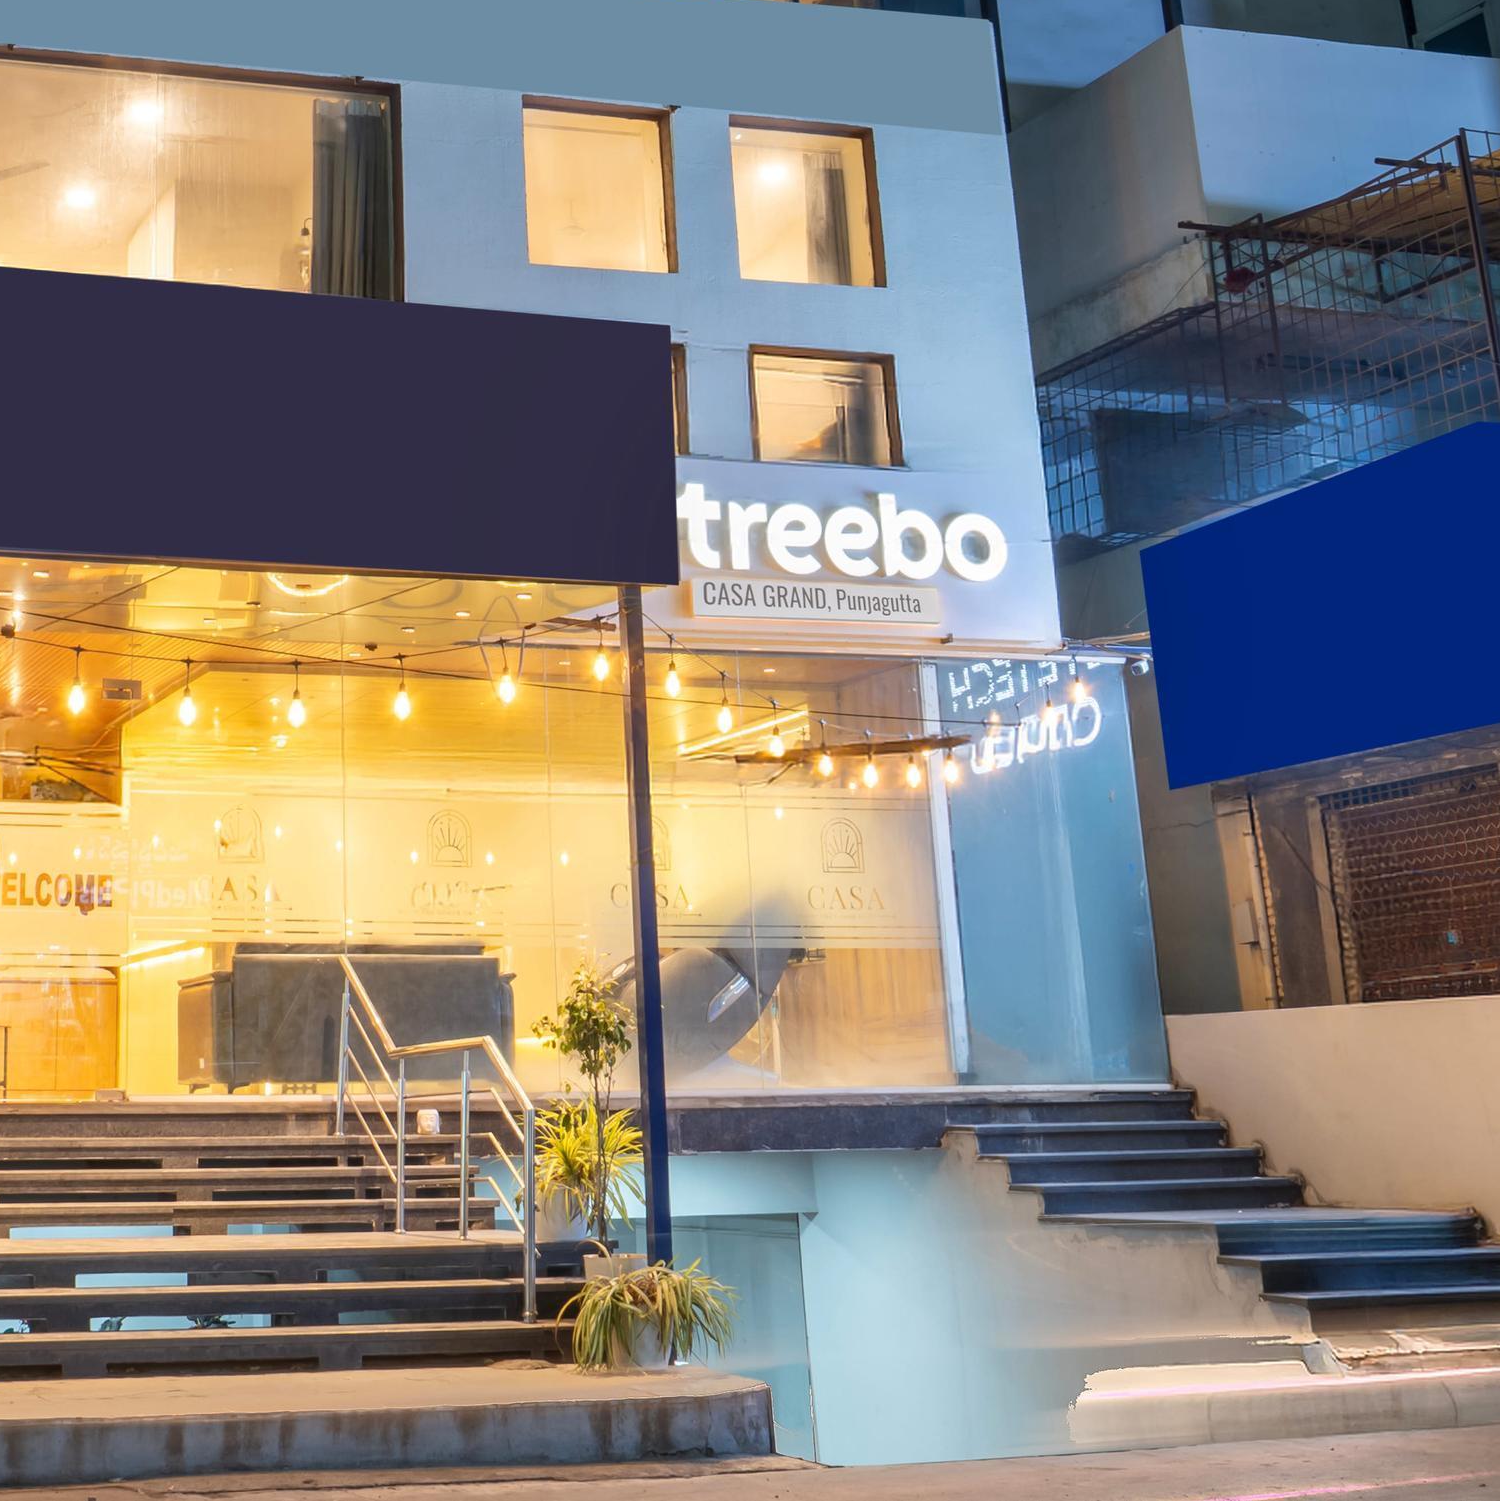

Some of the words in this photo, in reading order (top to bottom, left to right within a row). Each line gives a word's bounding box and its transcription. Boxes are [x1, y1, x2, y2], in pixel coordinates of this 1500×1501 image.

[676, 483, 1008, 582] treebo
[703, 581, 756, 607] CASA
[763, 585, 832, 613] GRAND,
[836, 589, 922, 616] Punjagutta
[610, 883, 690, 909] CSA
[807, 885, 885, 910] CASA
